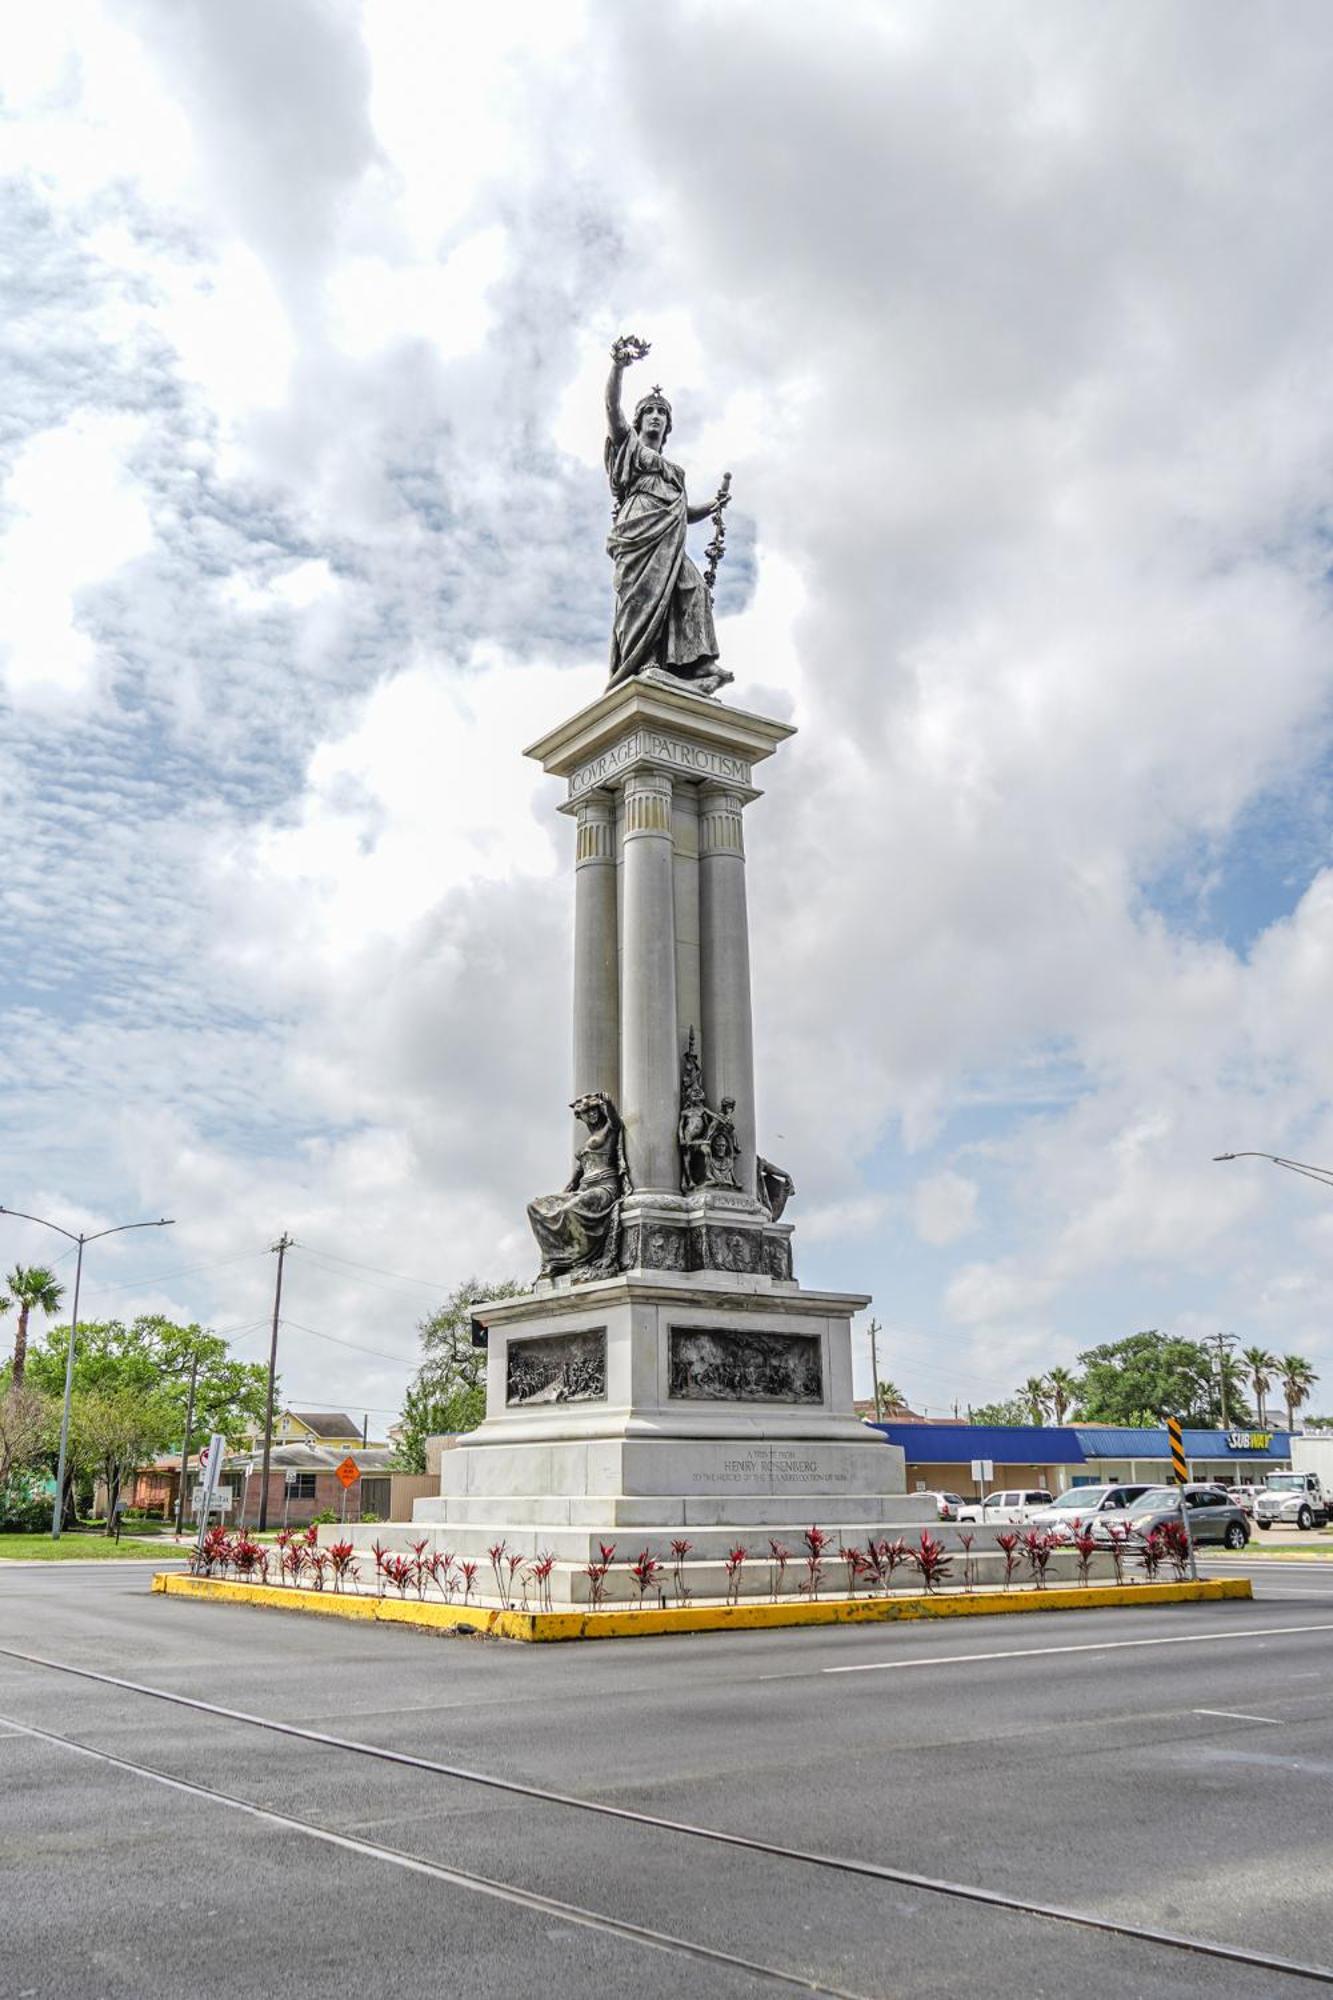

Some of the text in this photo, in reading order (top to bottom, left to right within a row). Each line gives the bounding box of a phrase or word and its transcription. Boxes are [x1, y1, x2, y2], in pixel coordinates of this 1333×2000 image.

[652, 736, 744, 783] PATRIOTISM
[1229, 1433, 1273, 1448] SUBWAY
[724, 1460, 817, 1472] HENRY ROSENBERG
